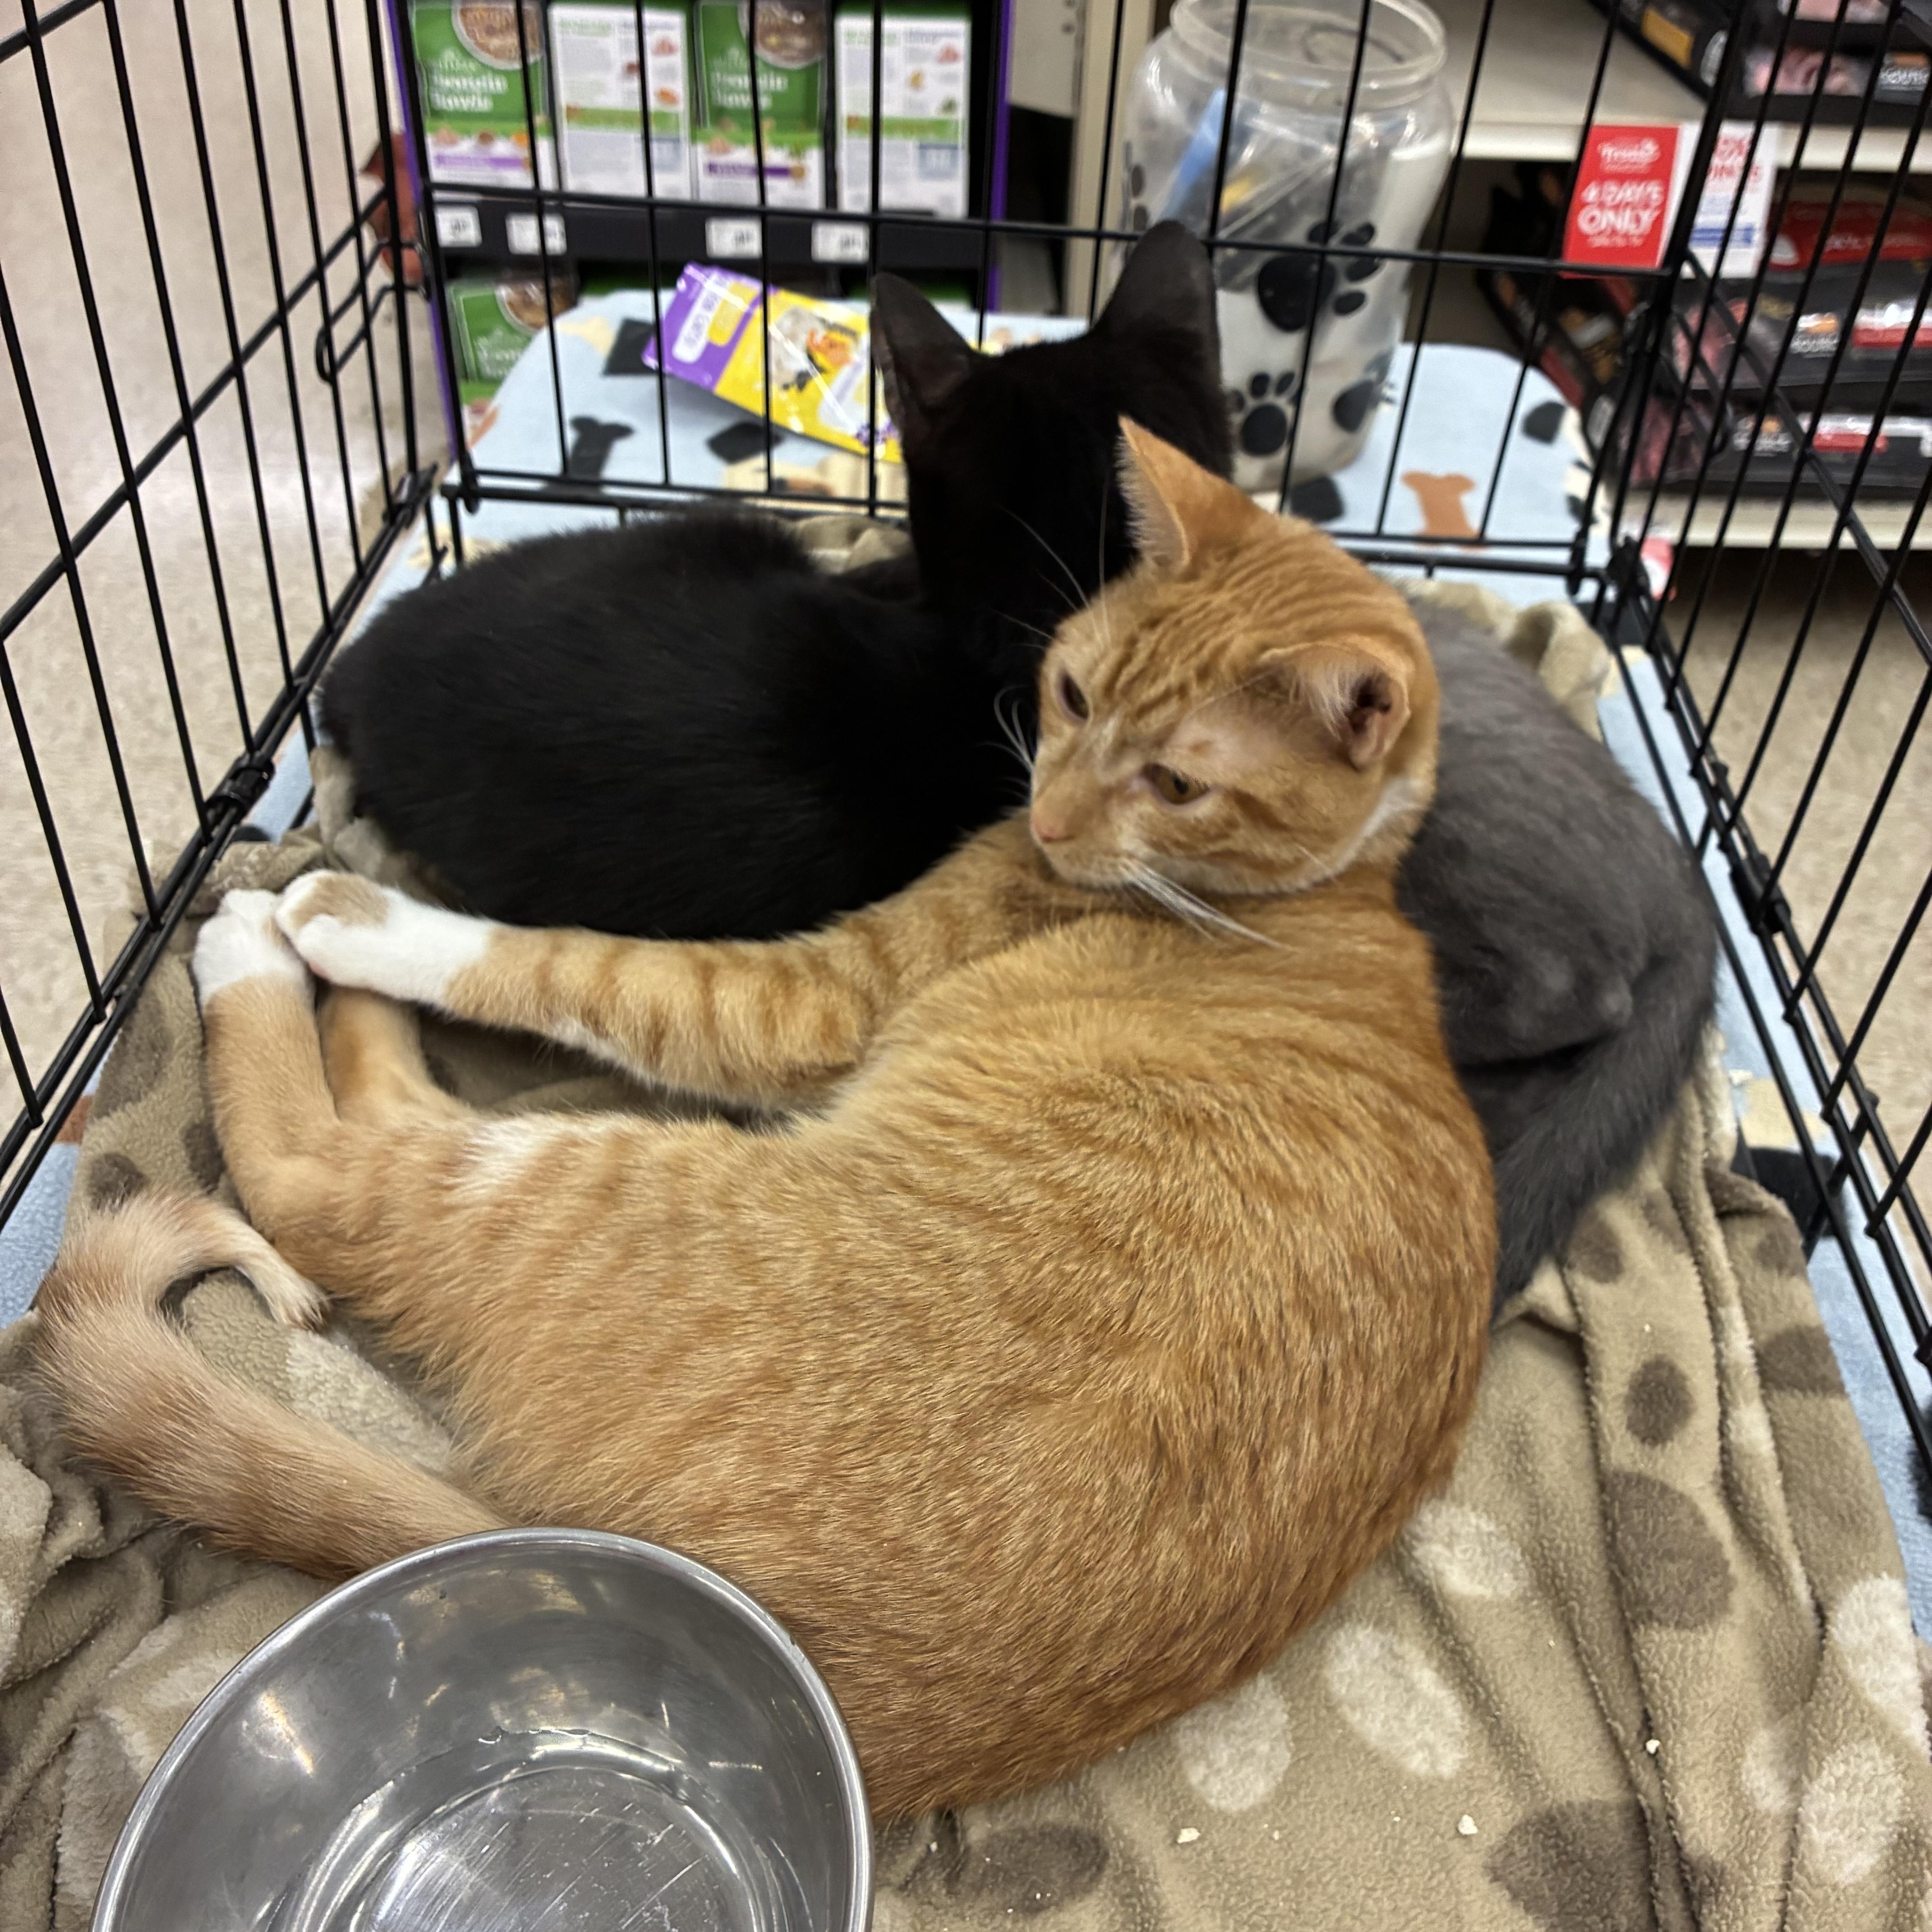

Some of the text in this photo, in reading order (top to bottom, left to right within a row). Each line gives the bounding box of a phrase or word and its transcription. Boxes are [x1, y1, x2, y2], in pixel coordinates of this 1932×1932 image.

[1581, 180, 1664, 205] 4 DAYS
[1578, 206, 1663, 235] ONLY
